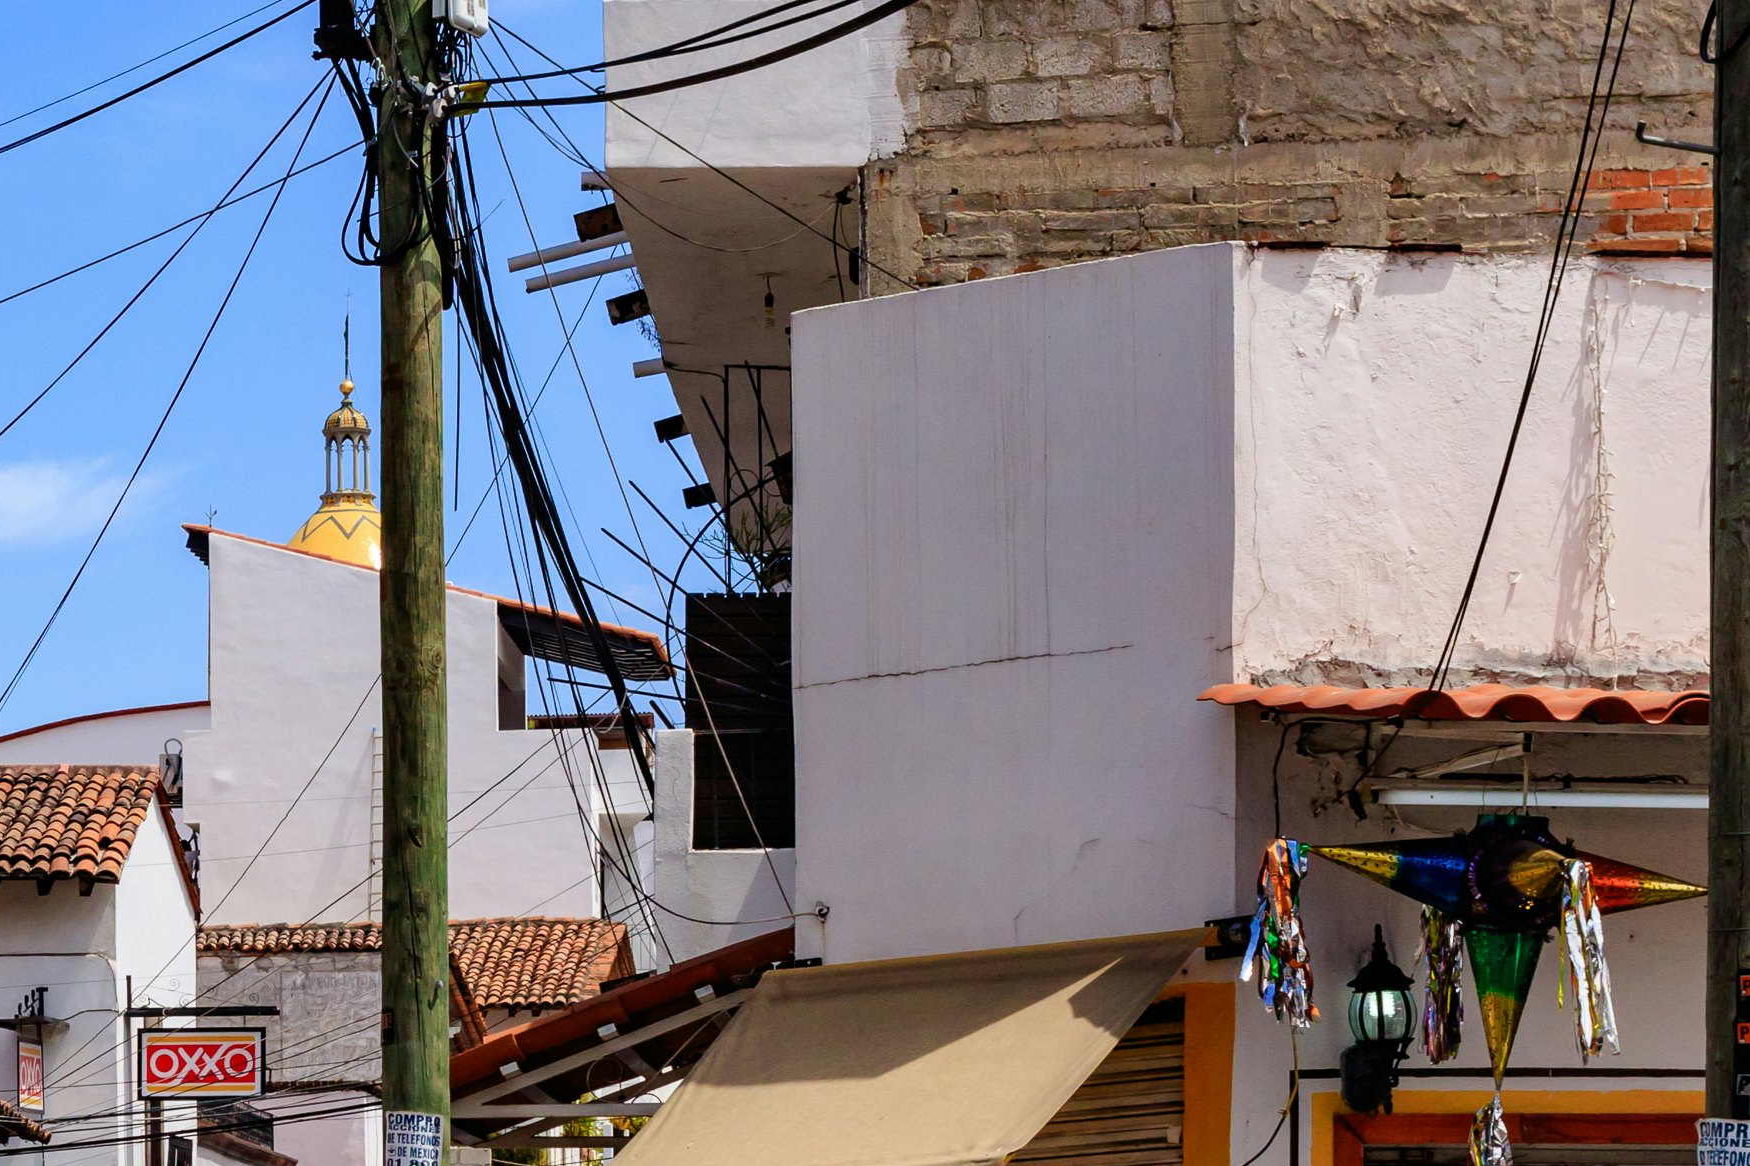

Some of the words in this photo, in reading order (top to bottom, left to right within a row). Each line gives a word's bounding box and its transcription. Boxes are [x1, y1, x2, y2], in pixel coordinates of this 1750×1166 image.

[21, 1058, 41, 1095] OXXO
[150, 1045, 253, 1083] OXXO
[388, 1113, 441, 1127] COMPRO
[398, 1147, 407, 1157] DE
